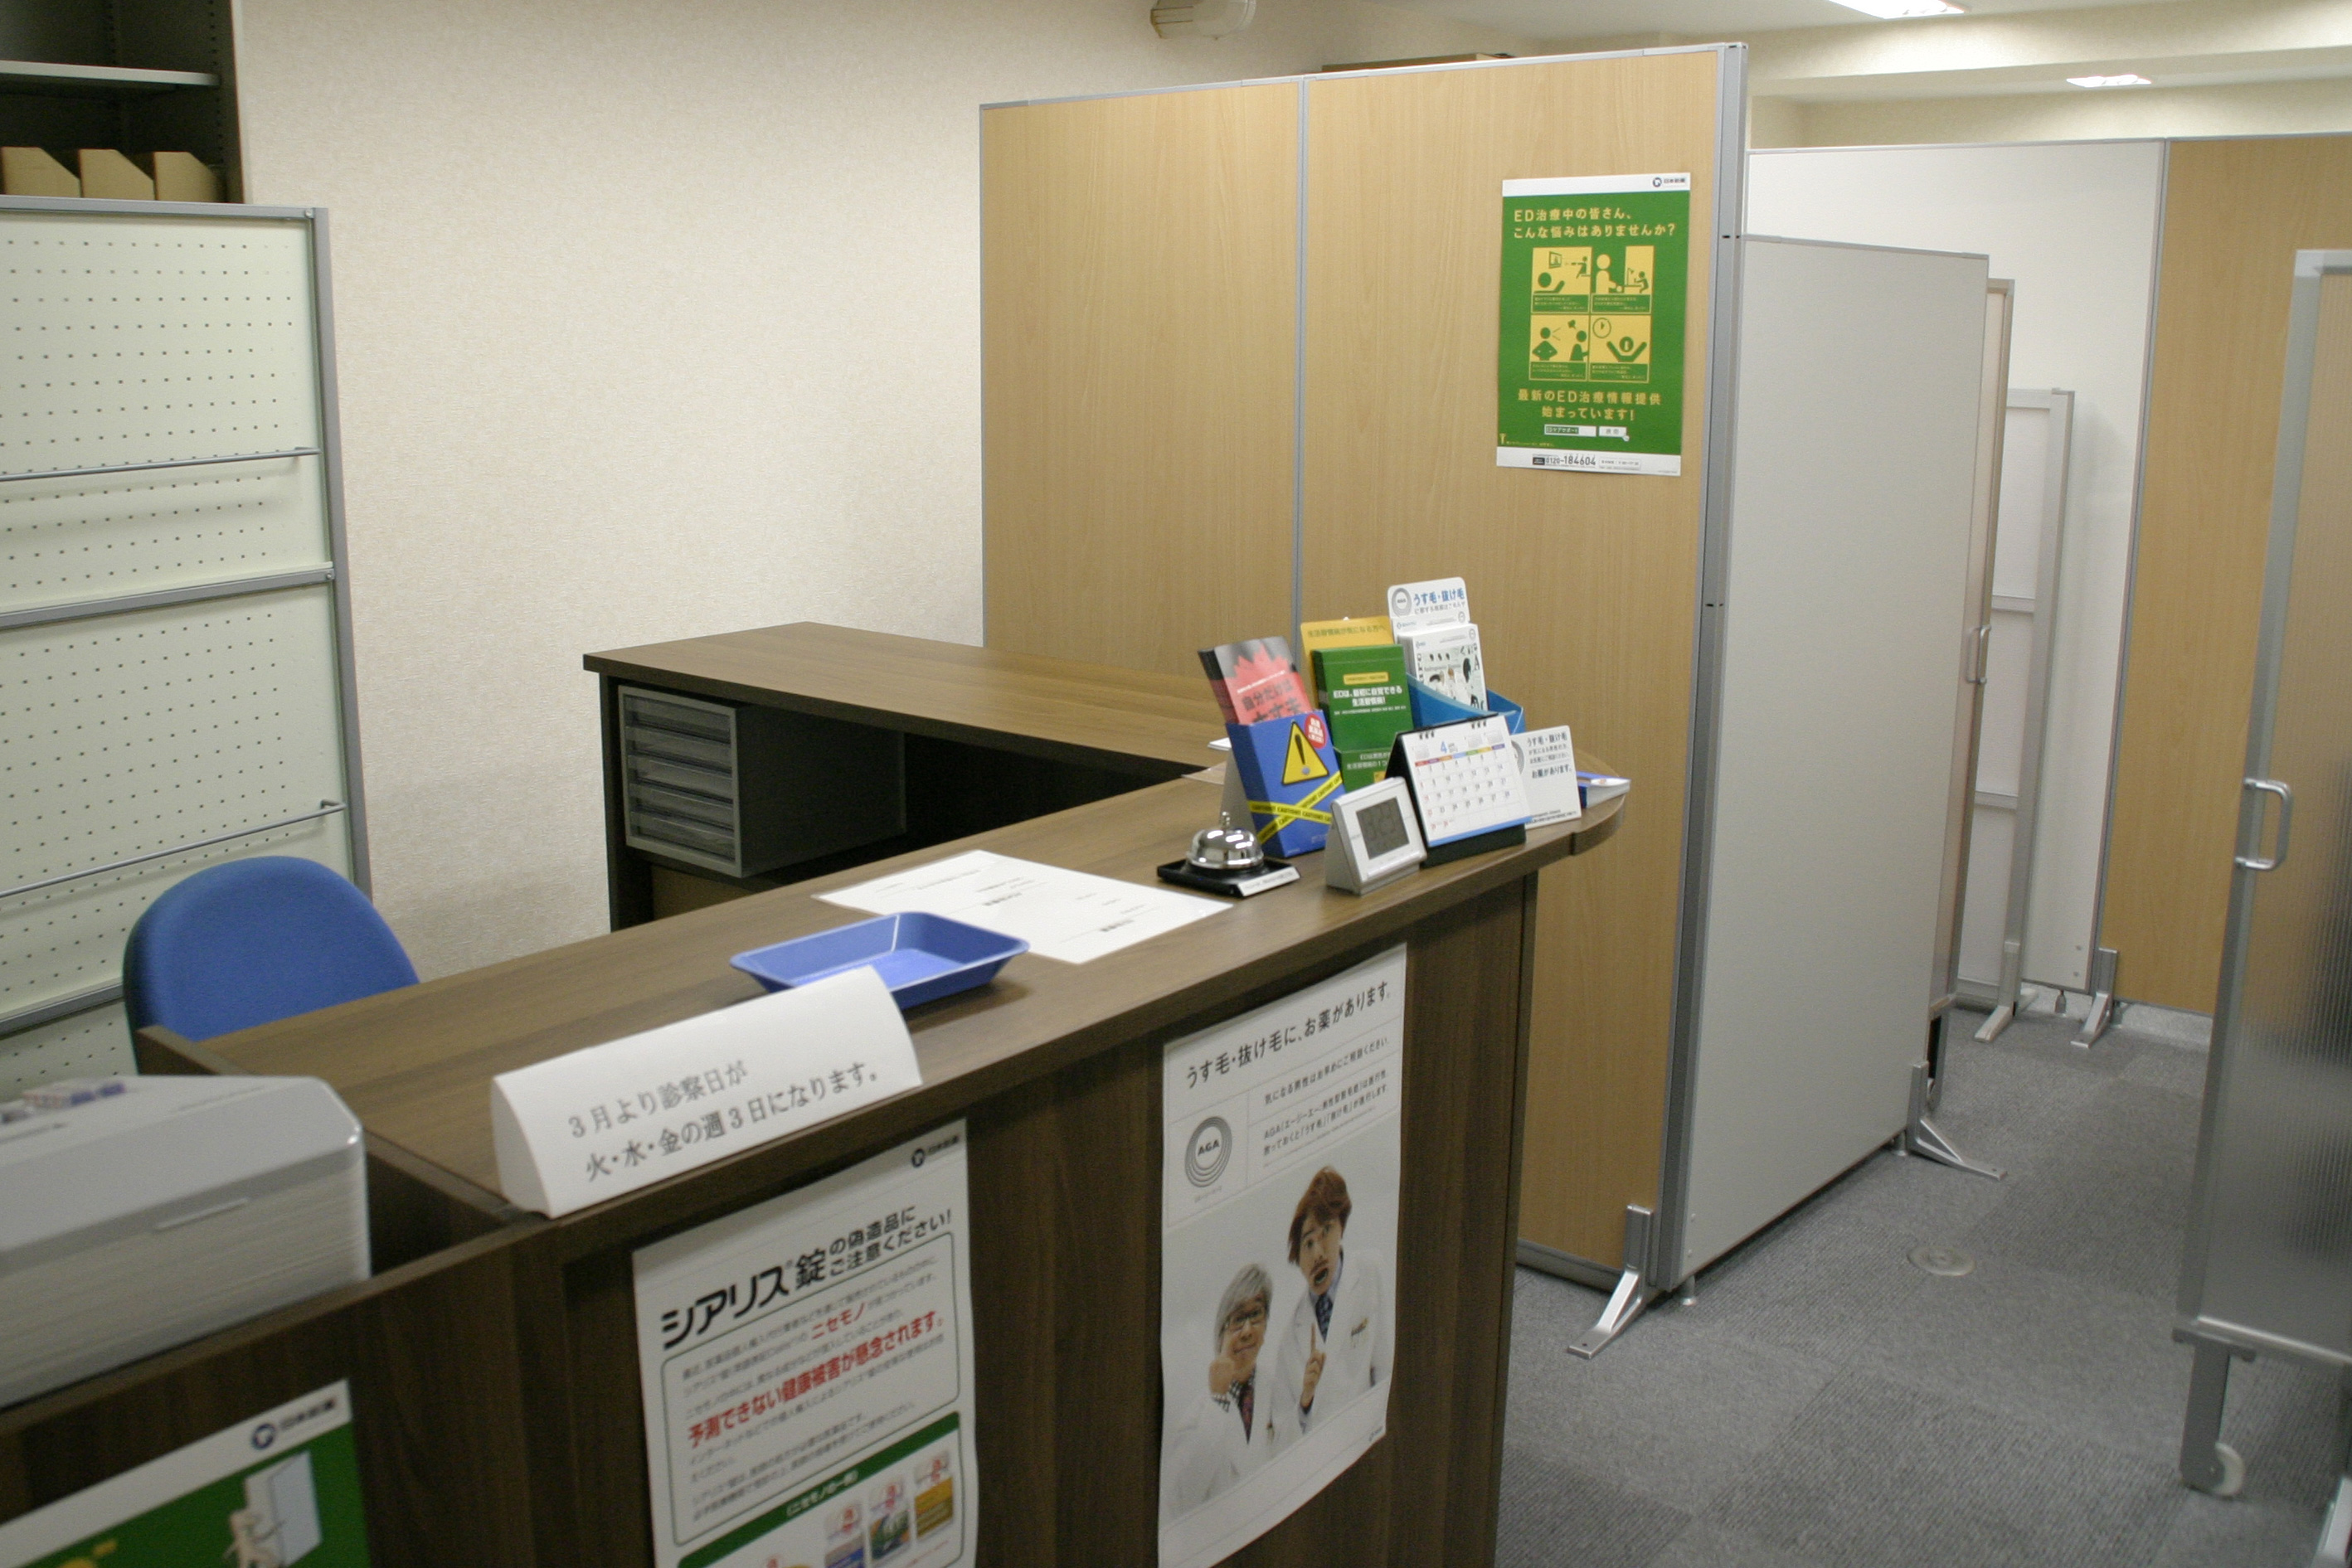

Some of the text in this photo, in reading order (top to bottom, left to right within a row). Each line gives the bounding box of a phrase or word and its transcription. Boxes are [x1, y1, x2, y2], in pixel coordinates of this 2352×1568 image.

[1514, 207, 1632, 222] ED治療中の皆さん、
[1514, 223, 1676, 239] こんな悩みはありませんか?
[1518, 388, 1663, 405] 最新のED治療情報提供
[1541, 405, 1636, 421] 始まっています!
[569, 1060, 748, 1138] 3月より診察日が
[586, 1062, 877, 1182] 火・水・金の週3日になります。
[1198, 1138, 1221, 1157] AGA
[830, 1209, 951, 1277] ご注意ください!
[811, 1302, 865, 1340] ニセモノ
